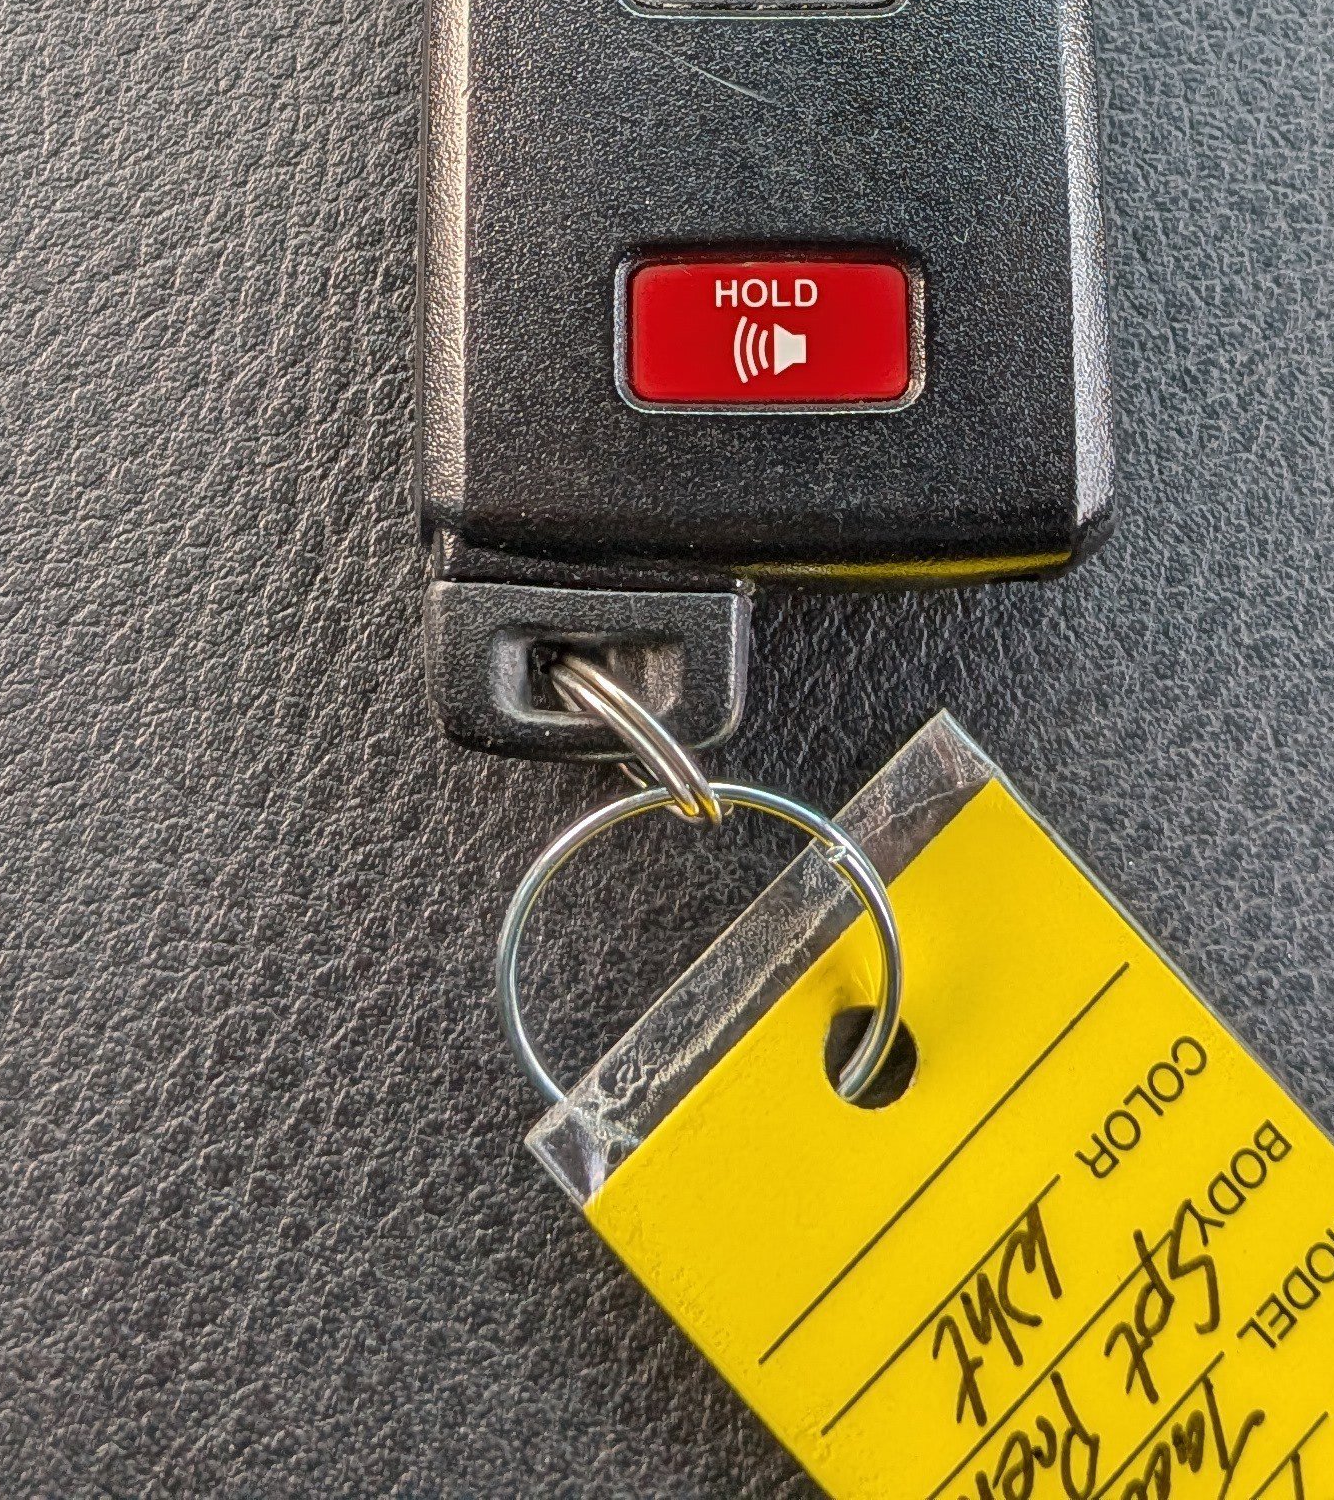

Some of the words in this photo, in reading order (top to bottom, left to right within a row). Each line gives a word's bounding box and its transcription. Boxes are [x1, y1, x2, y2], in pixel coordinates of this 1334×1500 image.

[714, 278, 818, 308] HOLD
[1074, 1035, 1208, 1179] COLOR
[1183, 1118, 1293, 1246] BODY
